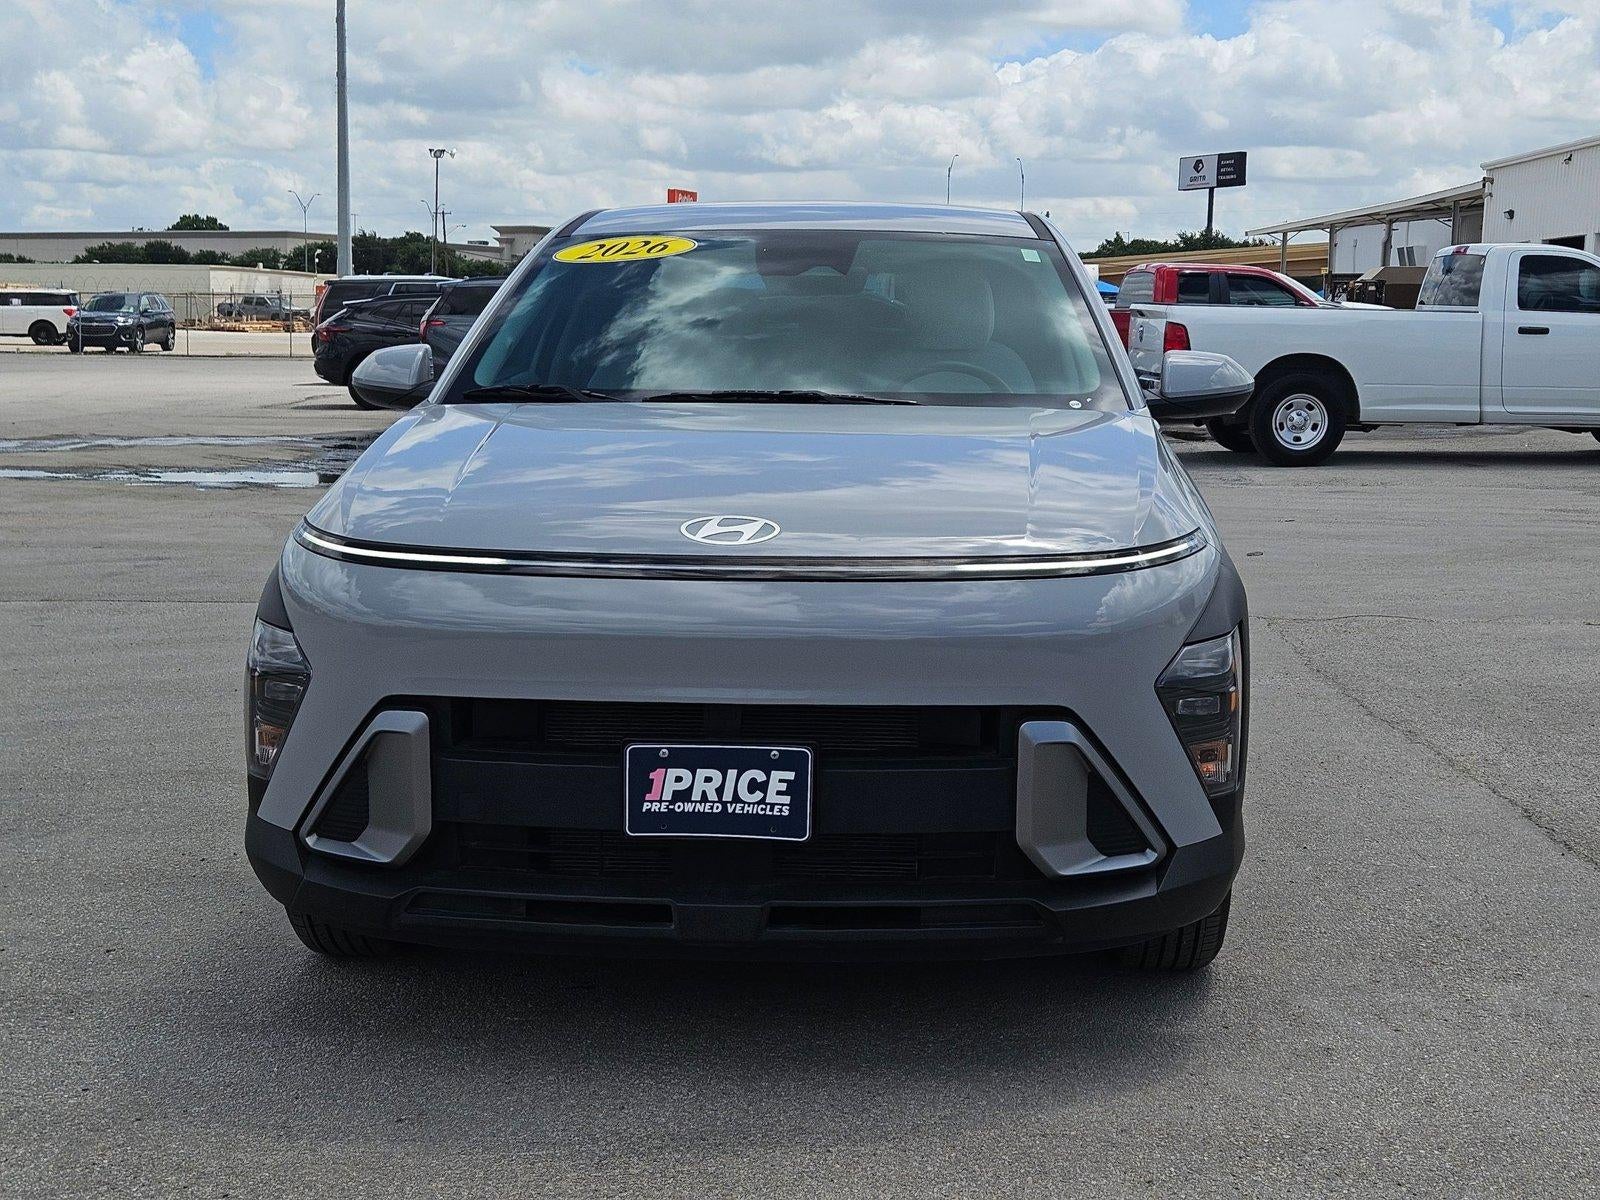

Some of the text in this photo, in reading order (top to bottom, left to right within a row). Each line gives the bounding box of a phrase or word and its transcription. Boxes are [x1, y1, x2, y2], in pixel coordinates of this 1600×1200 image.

[575, 239, 680, 260] 2026
[644, 768, 796, 805] 1PRICE
[642, 802, 790, 816] PRE-OWNED VEHICLES
